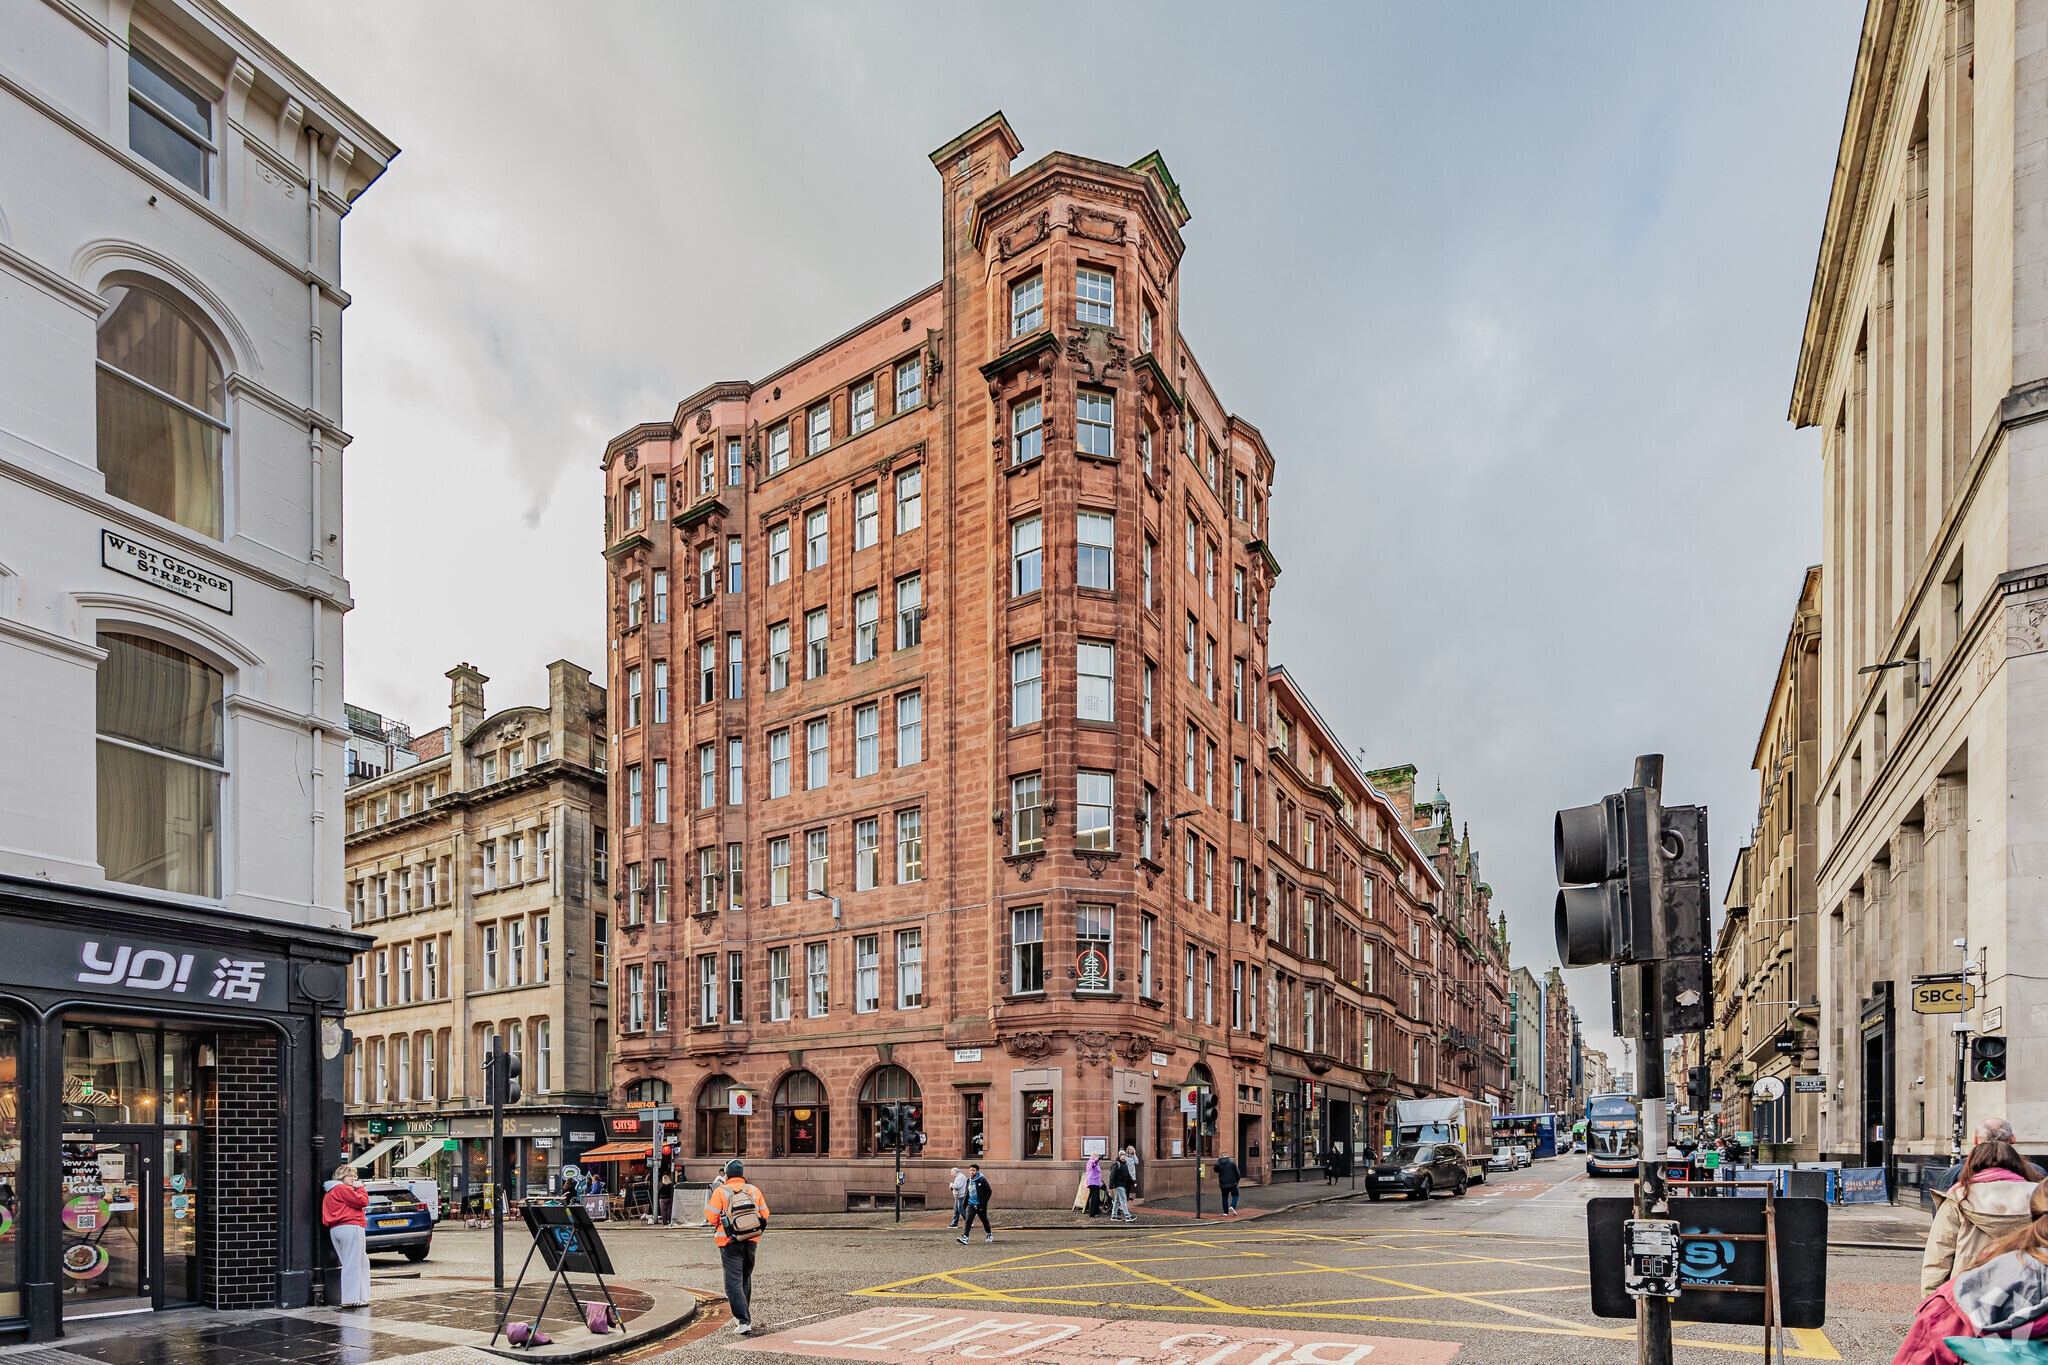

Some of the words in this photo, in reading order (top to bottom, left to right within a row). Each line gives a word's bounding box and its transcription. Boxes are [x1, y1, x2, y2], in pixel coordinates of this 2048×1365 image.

[107, 535, 159, 564] WEST
[162, 557, 228, 592] GEORGE
[137, 559, 202, 593] STREET
[166, 582, 188, 595] CENTRE
[77, 941, 195, 993] YO!
[208, 957, 266, 1002] 活
[70, 1184, 112, 1193] katsu
[1845, 1179, 1883, 1187] SHILLING
[793, 1313, 1082, 1359] GATE
